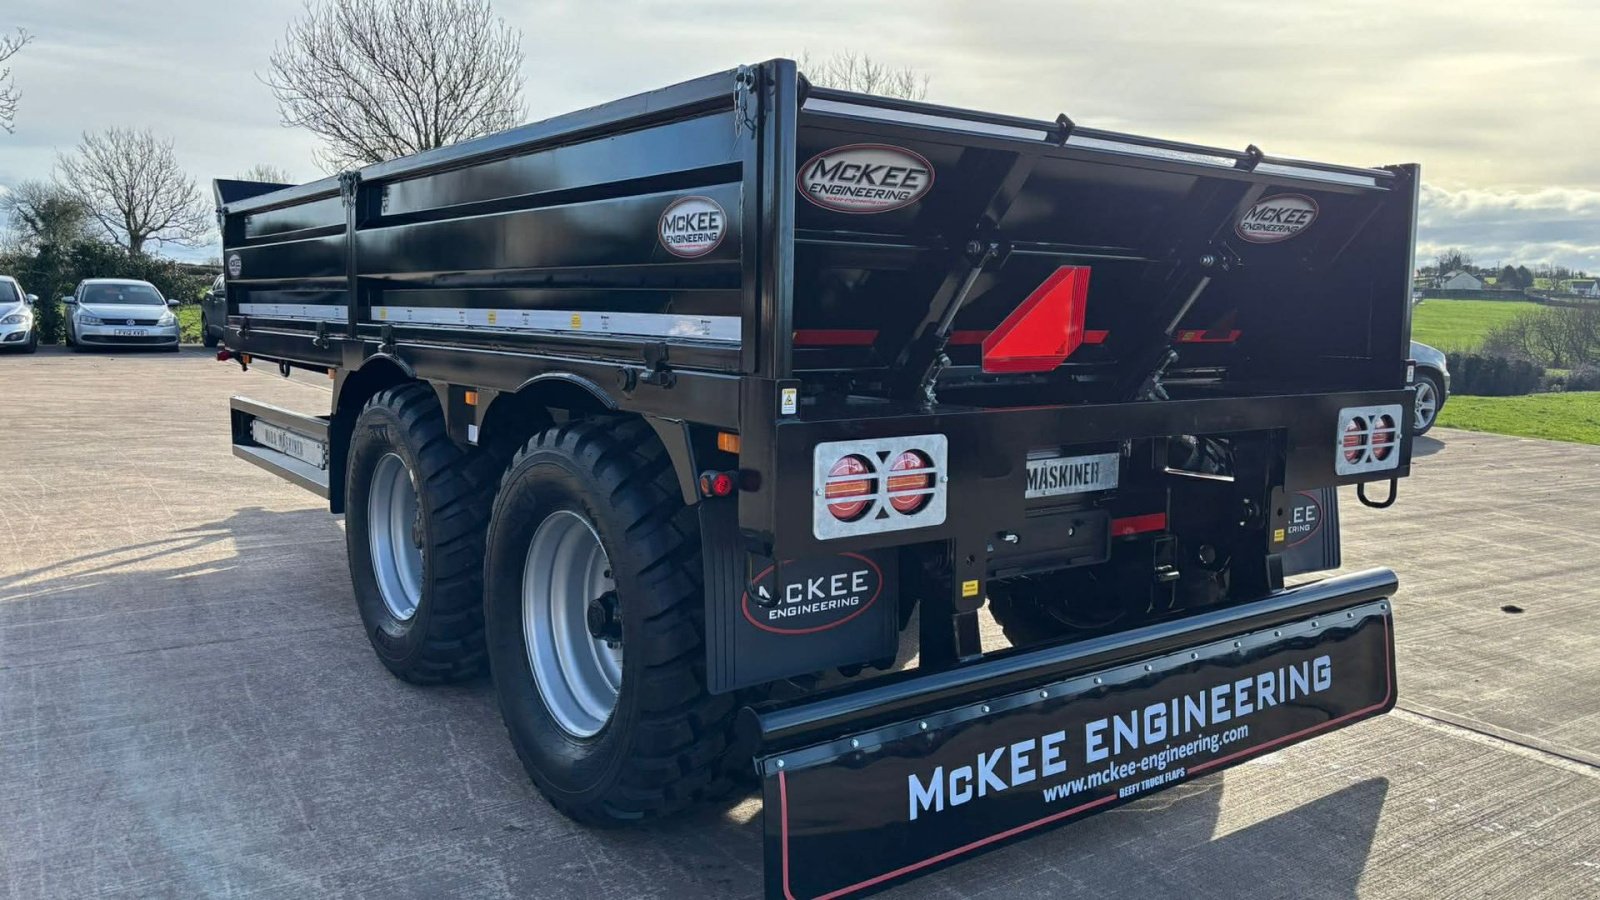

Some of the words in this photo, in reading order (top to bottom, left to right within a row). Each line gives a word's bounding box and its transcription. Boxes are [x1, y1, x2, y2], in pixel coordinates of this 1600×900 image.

[809, 159, 927, 191] McKEE
[809, 182, 912, 201] ENGINEERING
[663, 211, 720, 235] McKEE
[1244, 205, 1315, 225] McKEE
[666, 232, 718, 244] ENGINEERING
[1242, 222, 1300, 234] ENGINEERING
[768, 596, 860, 620] ENGINEERING
[908, 730, 1067, 822] McKEE
[1085, 654, 1332, 764] ENGINEERING
[1043, 724, 1249, 803] www.mckee-engineering.com
[1119, 784, 1140, 799] BEEFY
[1141, 776, 1165, 791] TRUCK
[1165, 767, 1186, 782] FLAPS
